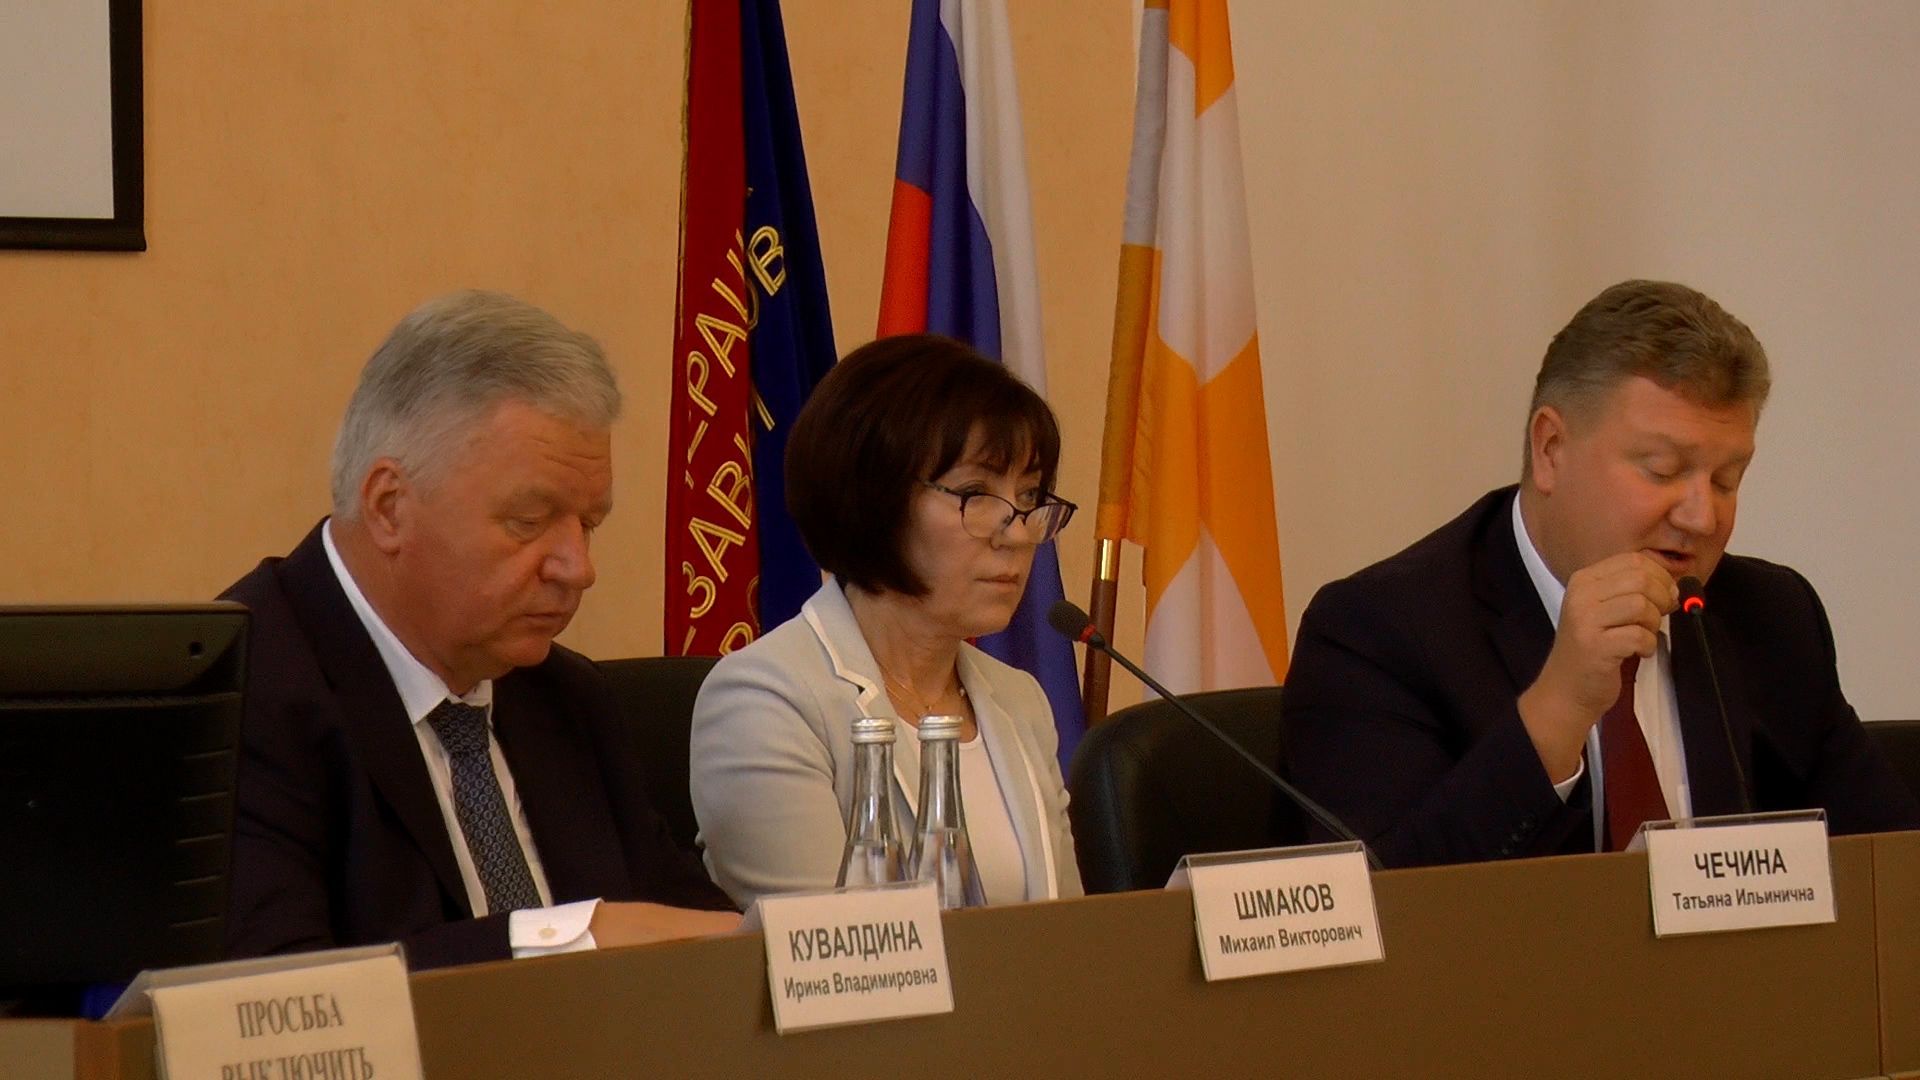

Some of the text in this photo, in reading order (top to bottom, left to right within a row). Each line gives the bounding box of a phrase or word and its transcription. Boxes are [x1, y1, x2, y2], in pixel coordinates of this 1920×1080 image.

[1694, 849, 1787, 879] ЧЕЧИНА
[1234, 883, 1335, 920] ШМАКОВ
[1672, 887, 1814, 910] Татьяна Ильинична
[788, 920, 922, 962] КУВАЛДИНА
[1219, 925, 1362, 954] Михаил Викторович
[784, 967, 938, 1003] Ирина Владимировна
